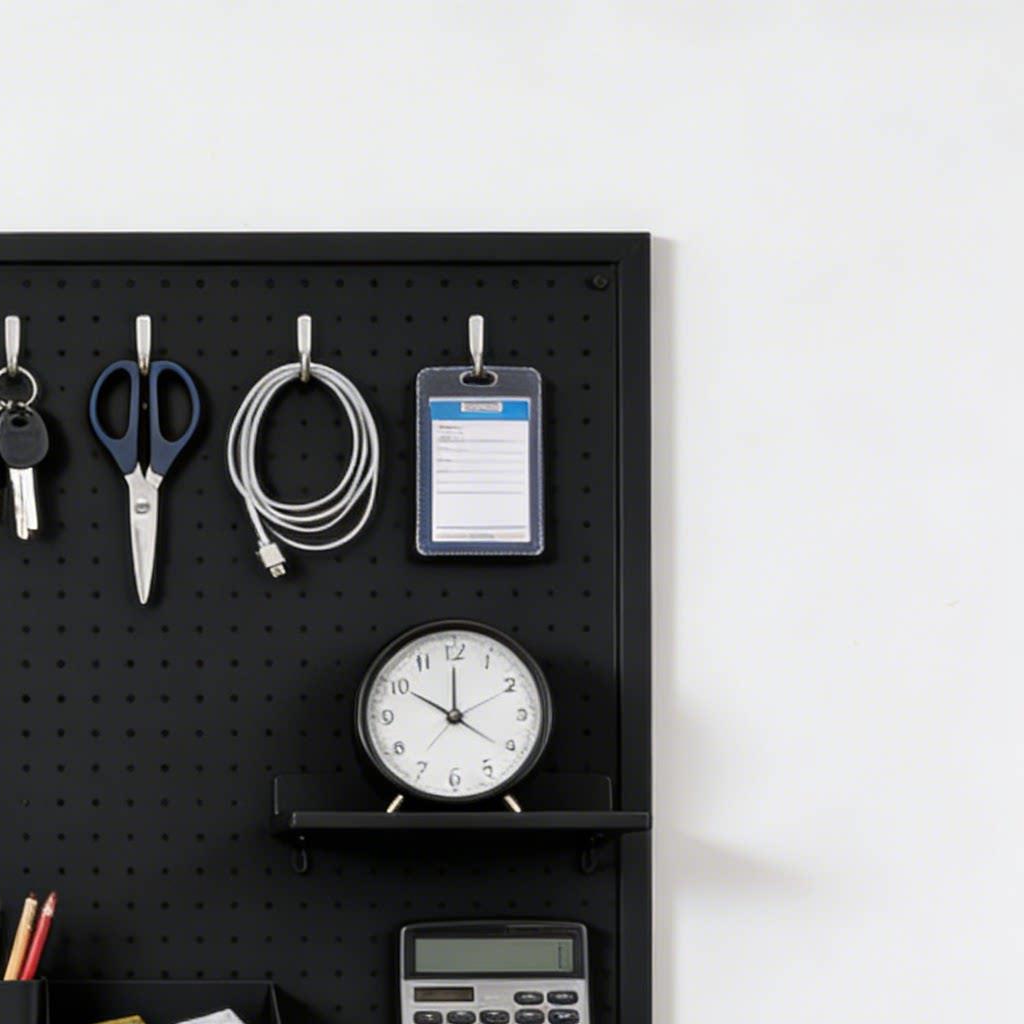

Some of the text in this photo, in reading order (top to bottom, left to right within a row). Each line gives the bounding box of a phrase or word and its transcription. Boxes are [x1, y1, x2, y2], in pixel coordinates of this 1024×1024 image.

[446, 644, 465, 661] 12
[417, 654, 429, 672] 11
[485, 654, 490, 670] 1
[391, 678, 409, 694] 10
[505, 678, 516, 692] 2
[382, 709, 394, 725] 9
[449, 768, 461, 786] 6
